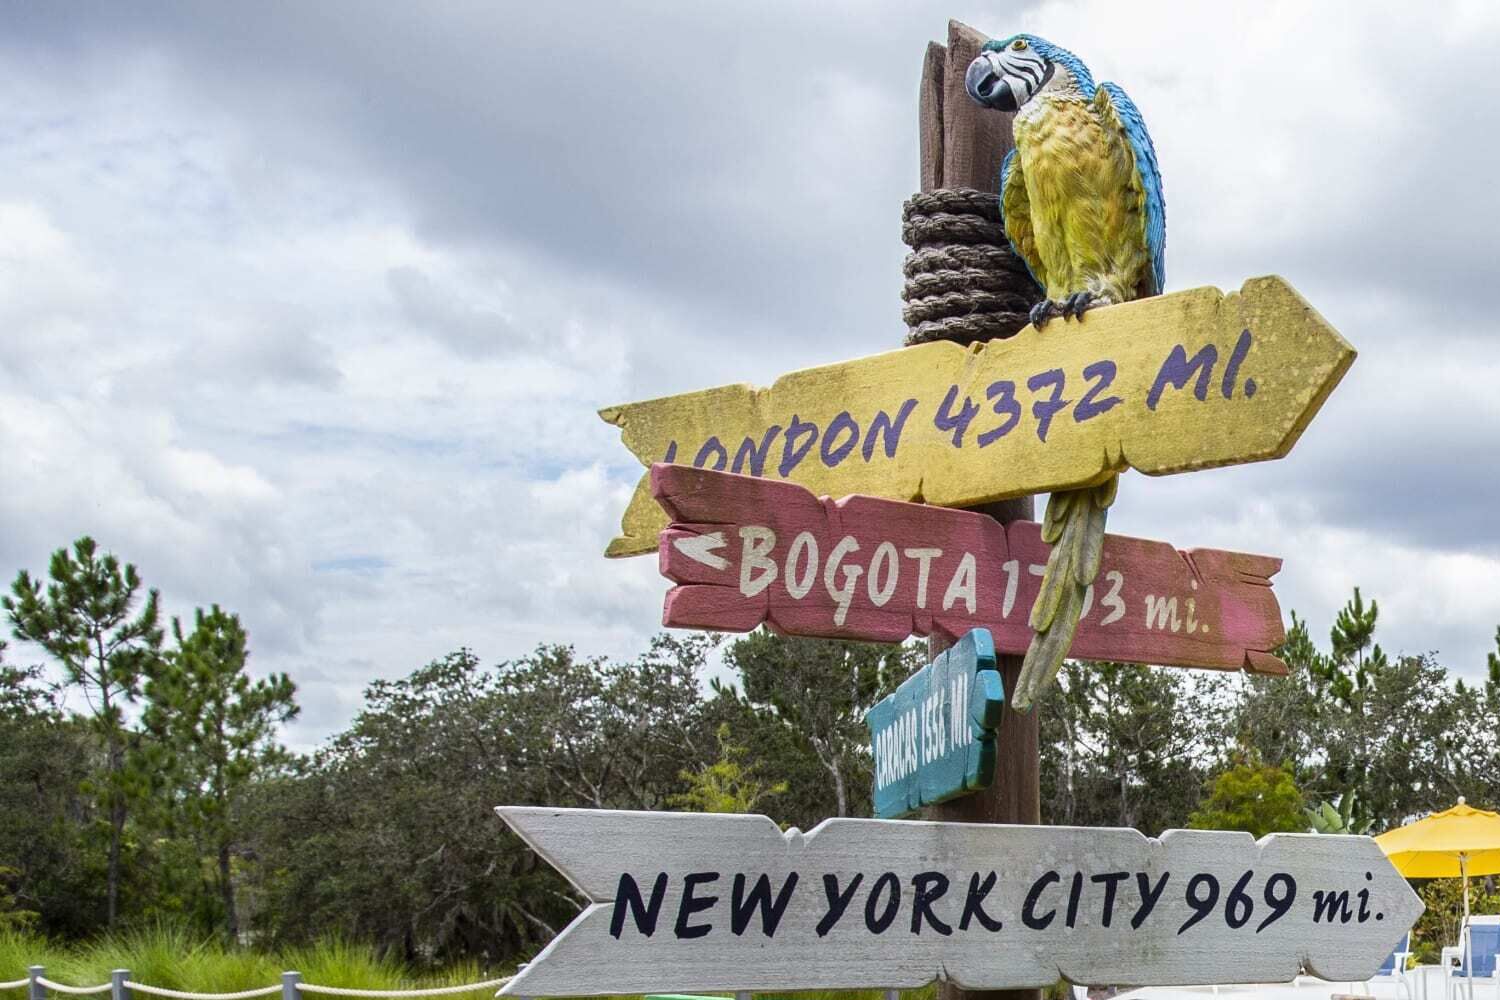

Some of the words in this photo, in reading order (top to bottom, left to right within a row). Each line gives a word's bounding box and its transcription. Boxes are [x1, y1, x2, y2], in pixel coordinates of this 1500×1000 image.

[934, 360, 1122, 448] 4372
[1146, 329, 1256, 412] MI.
[738, 526, 977, 626] BOGOTA
[876, 708, 918, 791] CARACAS
[610, 872, 800, 940] NEW
[815, 870, 1003, 937] YORK
[1021, 870, 1170, 931] CITY
[1176, 870, 1297, 936] 969
[1312, 871, 1386, 924] mi.
